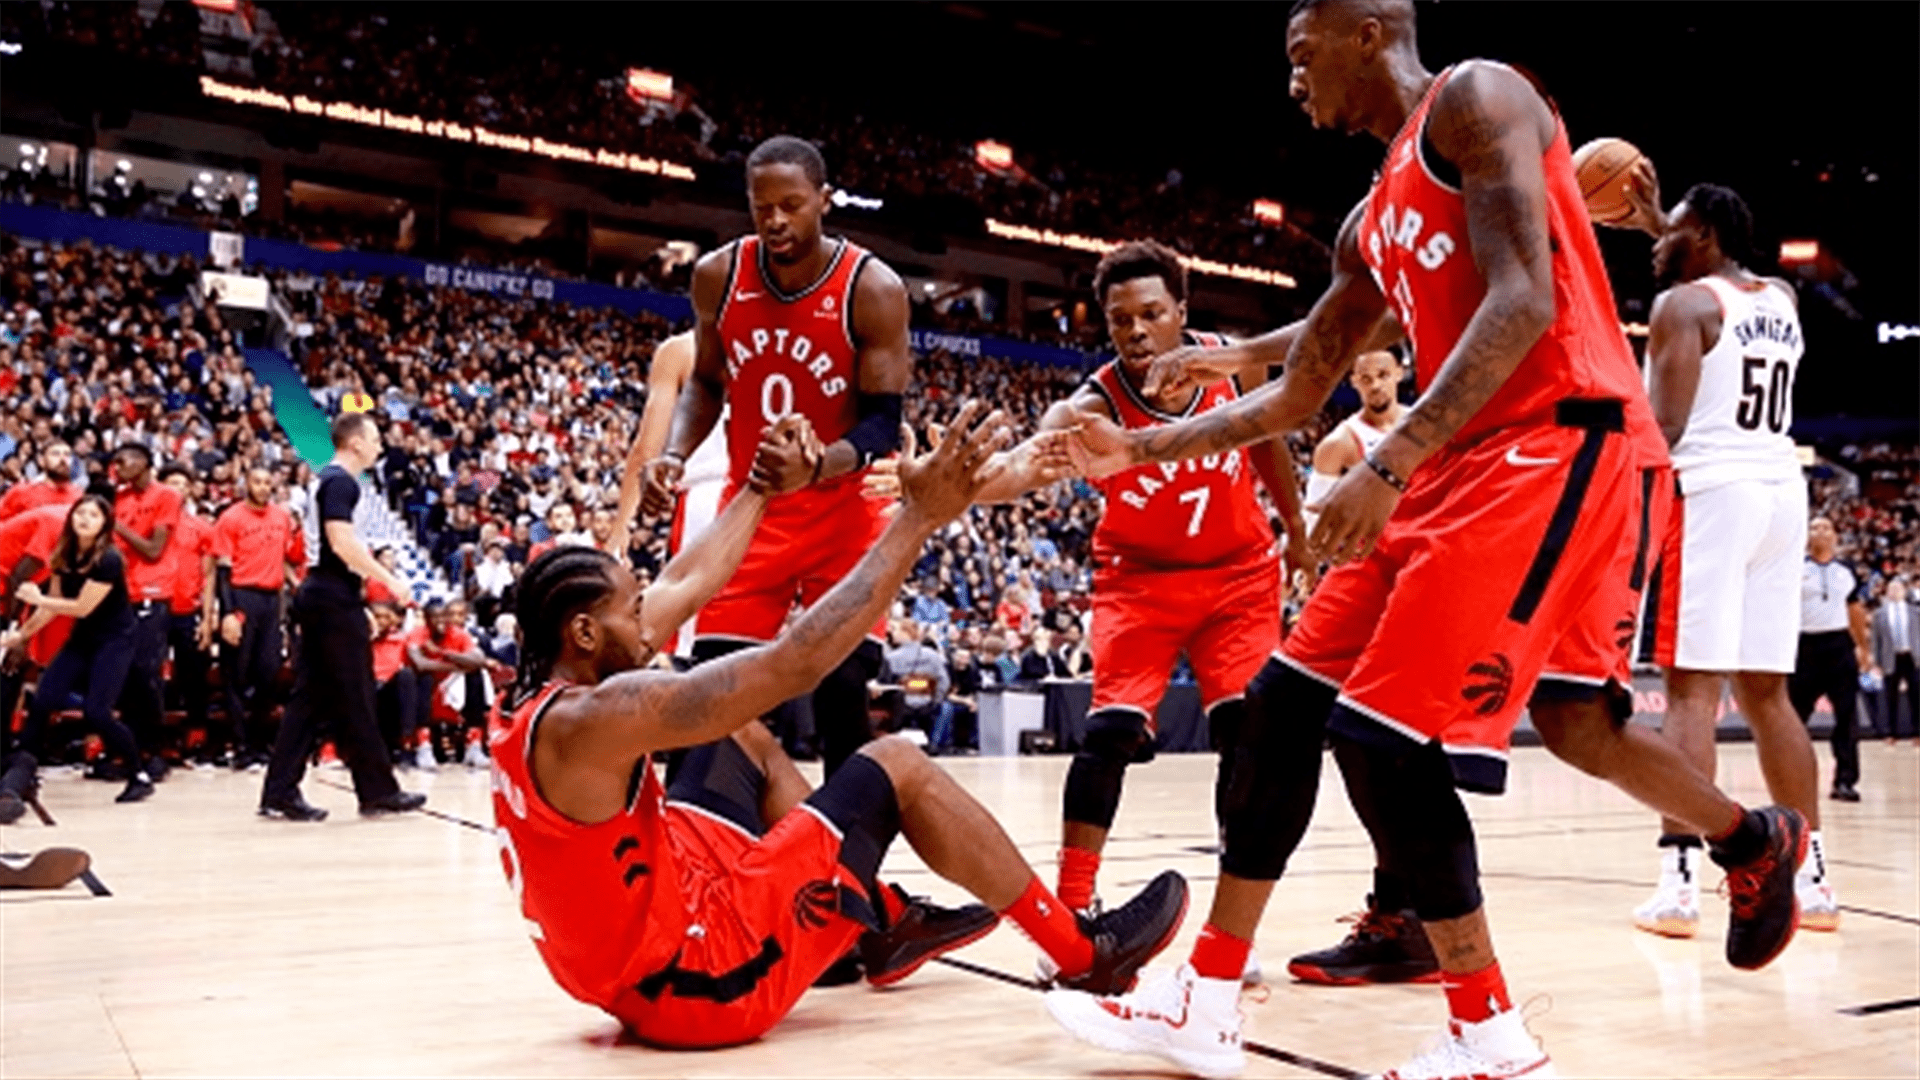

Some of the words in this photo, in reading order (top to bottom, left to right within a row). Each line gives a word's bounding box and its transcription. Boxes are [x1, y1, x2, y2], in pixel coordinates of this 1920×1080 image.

[761, 372, 793, 425] 0
[1736, 355, 1790, 434] 50
[1178, 485, 1211, 537] 7
